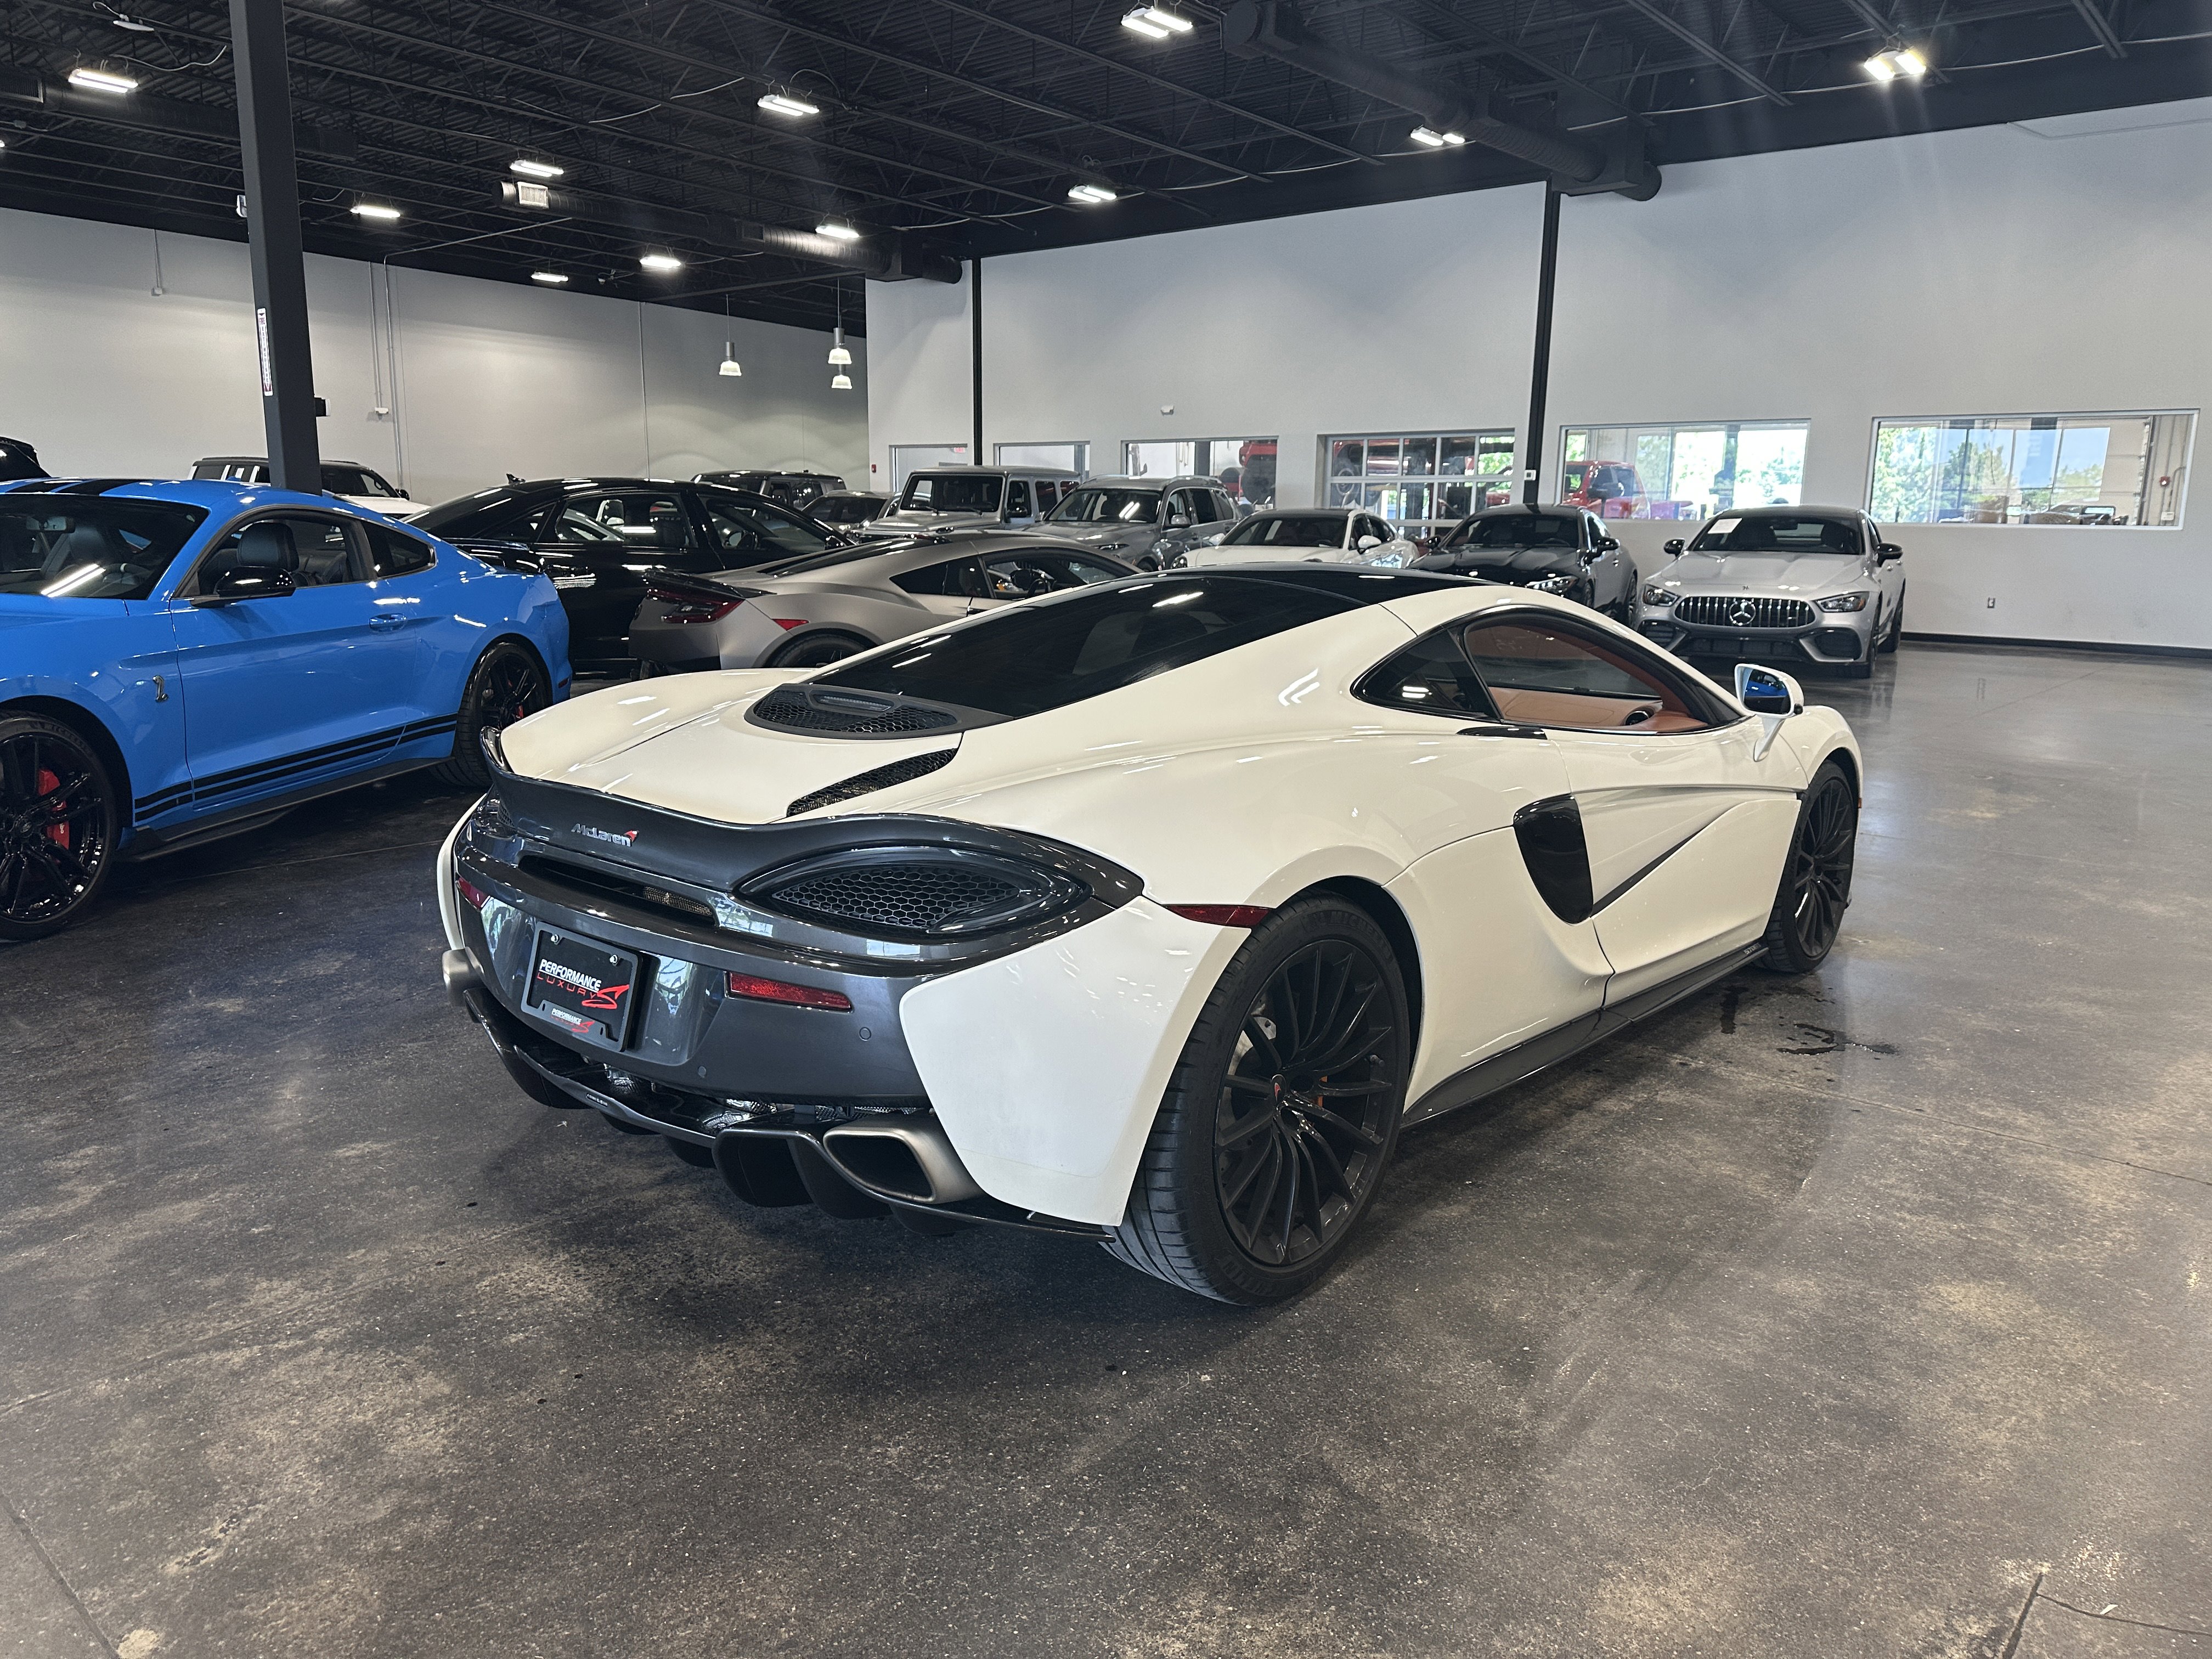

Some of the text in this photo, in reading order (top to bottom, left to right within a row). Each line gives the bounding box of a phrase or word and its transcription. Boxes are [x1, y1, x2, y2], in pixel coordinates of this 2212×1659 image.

[571, 823, 631, 847] McLaren
[537, 972, 596, 998] LUXURY
[539, 959, 601, 991] PERFORMANCE
[551, 1008, 582, 1024] PERFORMANCE
